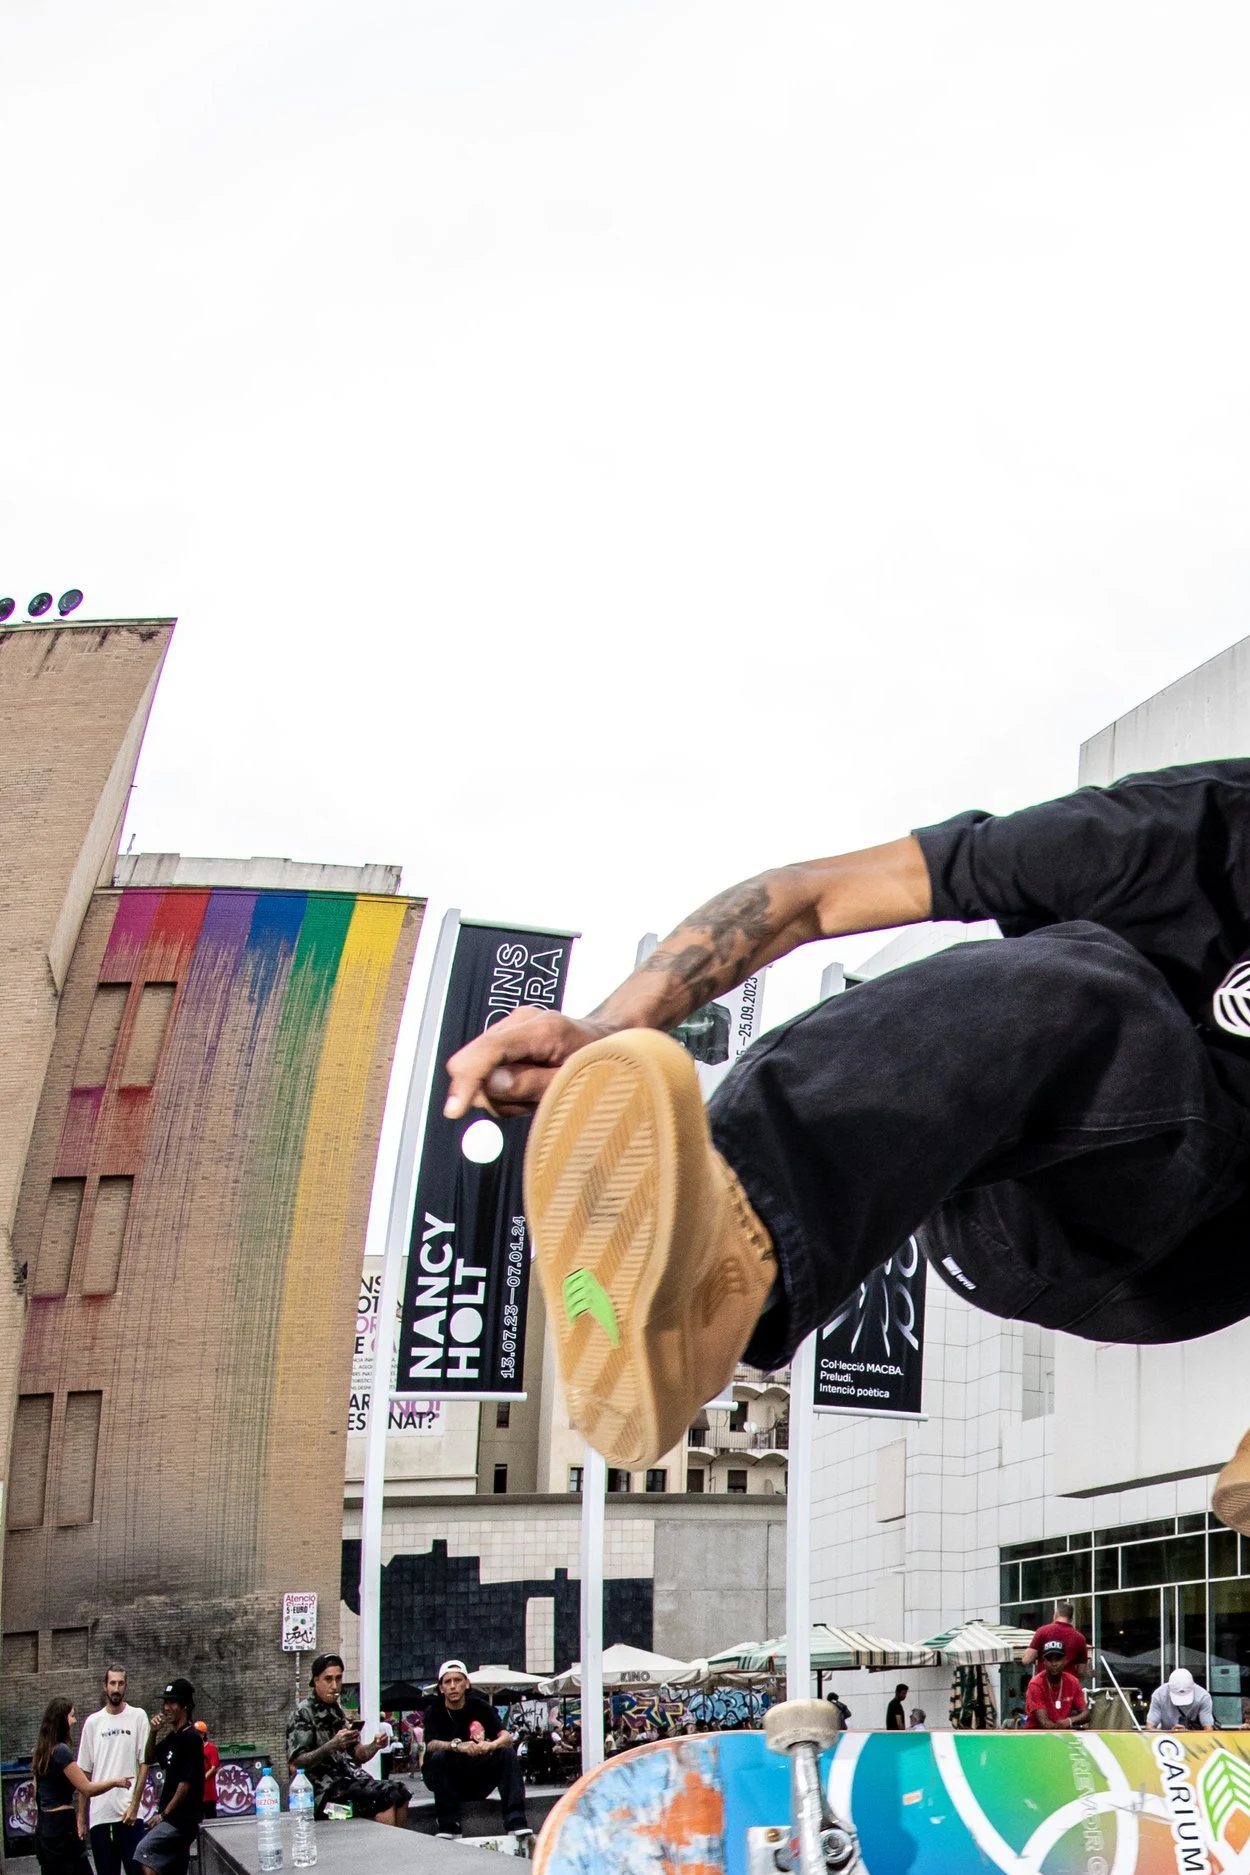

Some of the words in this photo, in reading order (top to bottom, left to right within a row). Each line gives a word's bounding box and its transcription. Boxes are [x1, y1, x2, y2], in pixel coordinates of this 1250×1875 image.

[523, 948, 563, 1011] RA
[409, 1211, 456, 1378] NANCY
[446, 1258, 487, 1378] HOLT
[820, 1370, 854, 1383] Preludi.
[866, 1363, 904, 1376] MACBA.
[819, 1383, 856, 1395] Intenció
[856, 1387, 890, 1399] poètica
[620, 1671, 651, 1682] KINO
